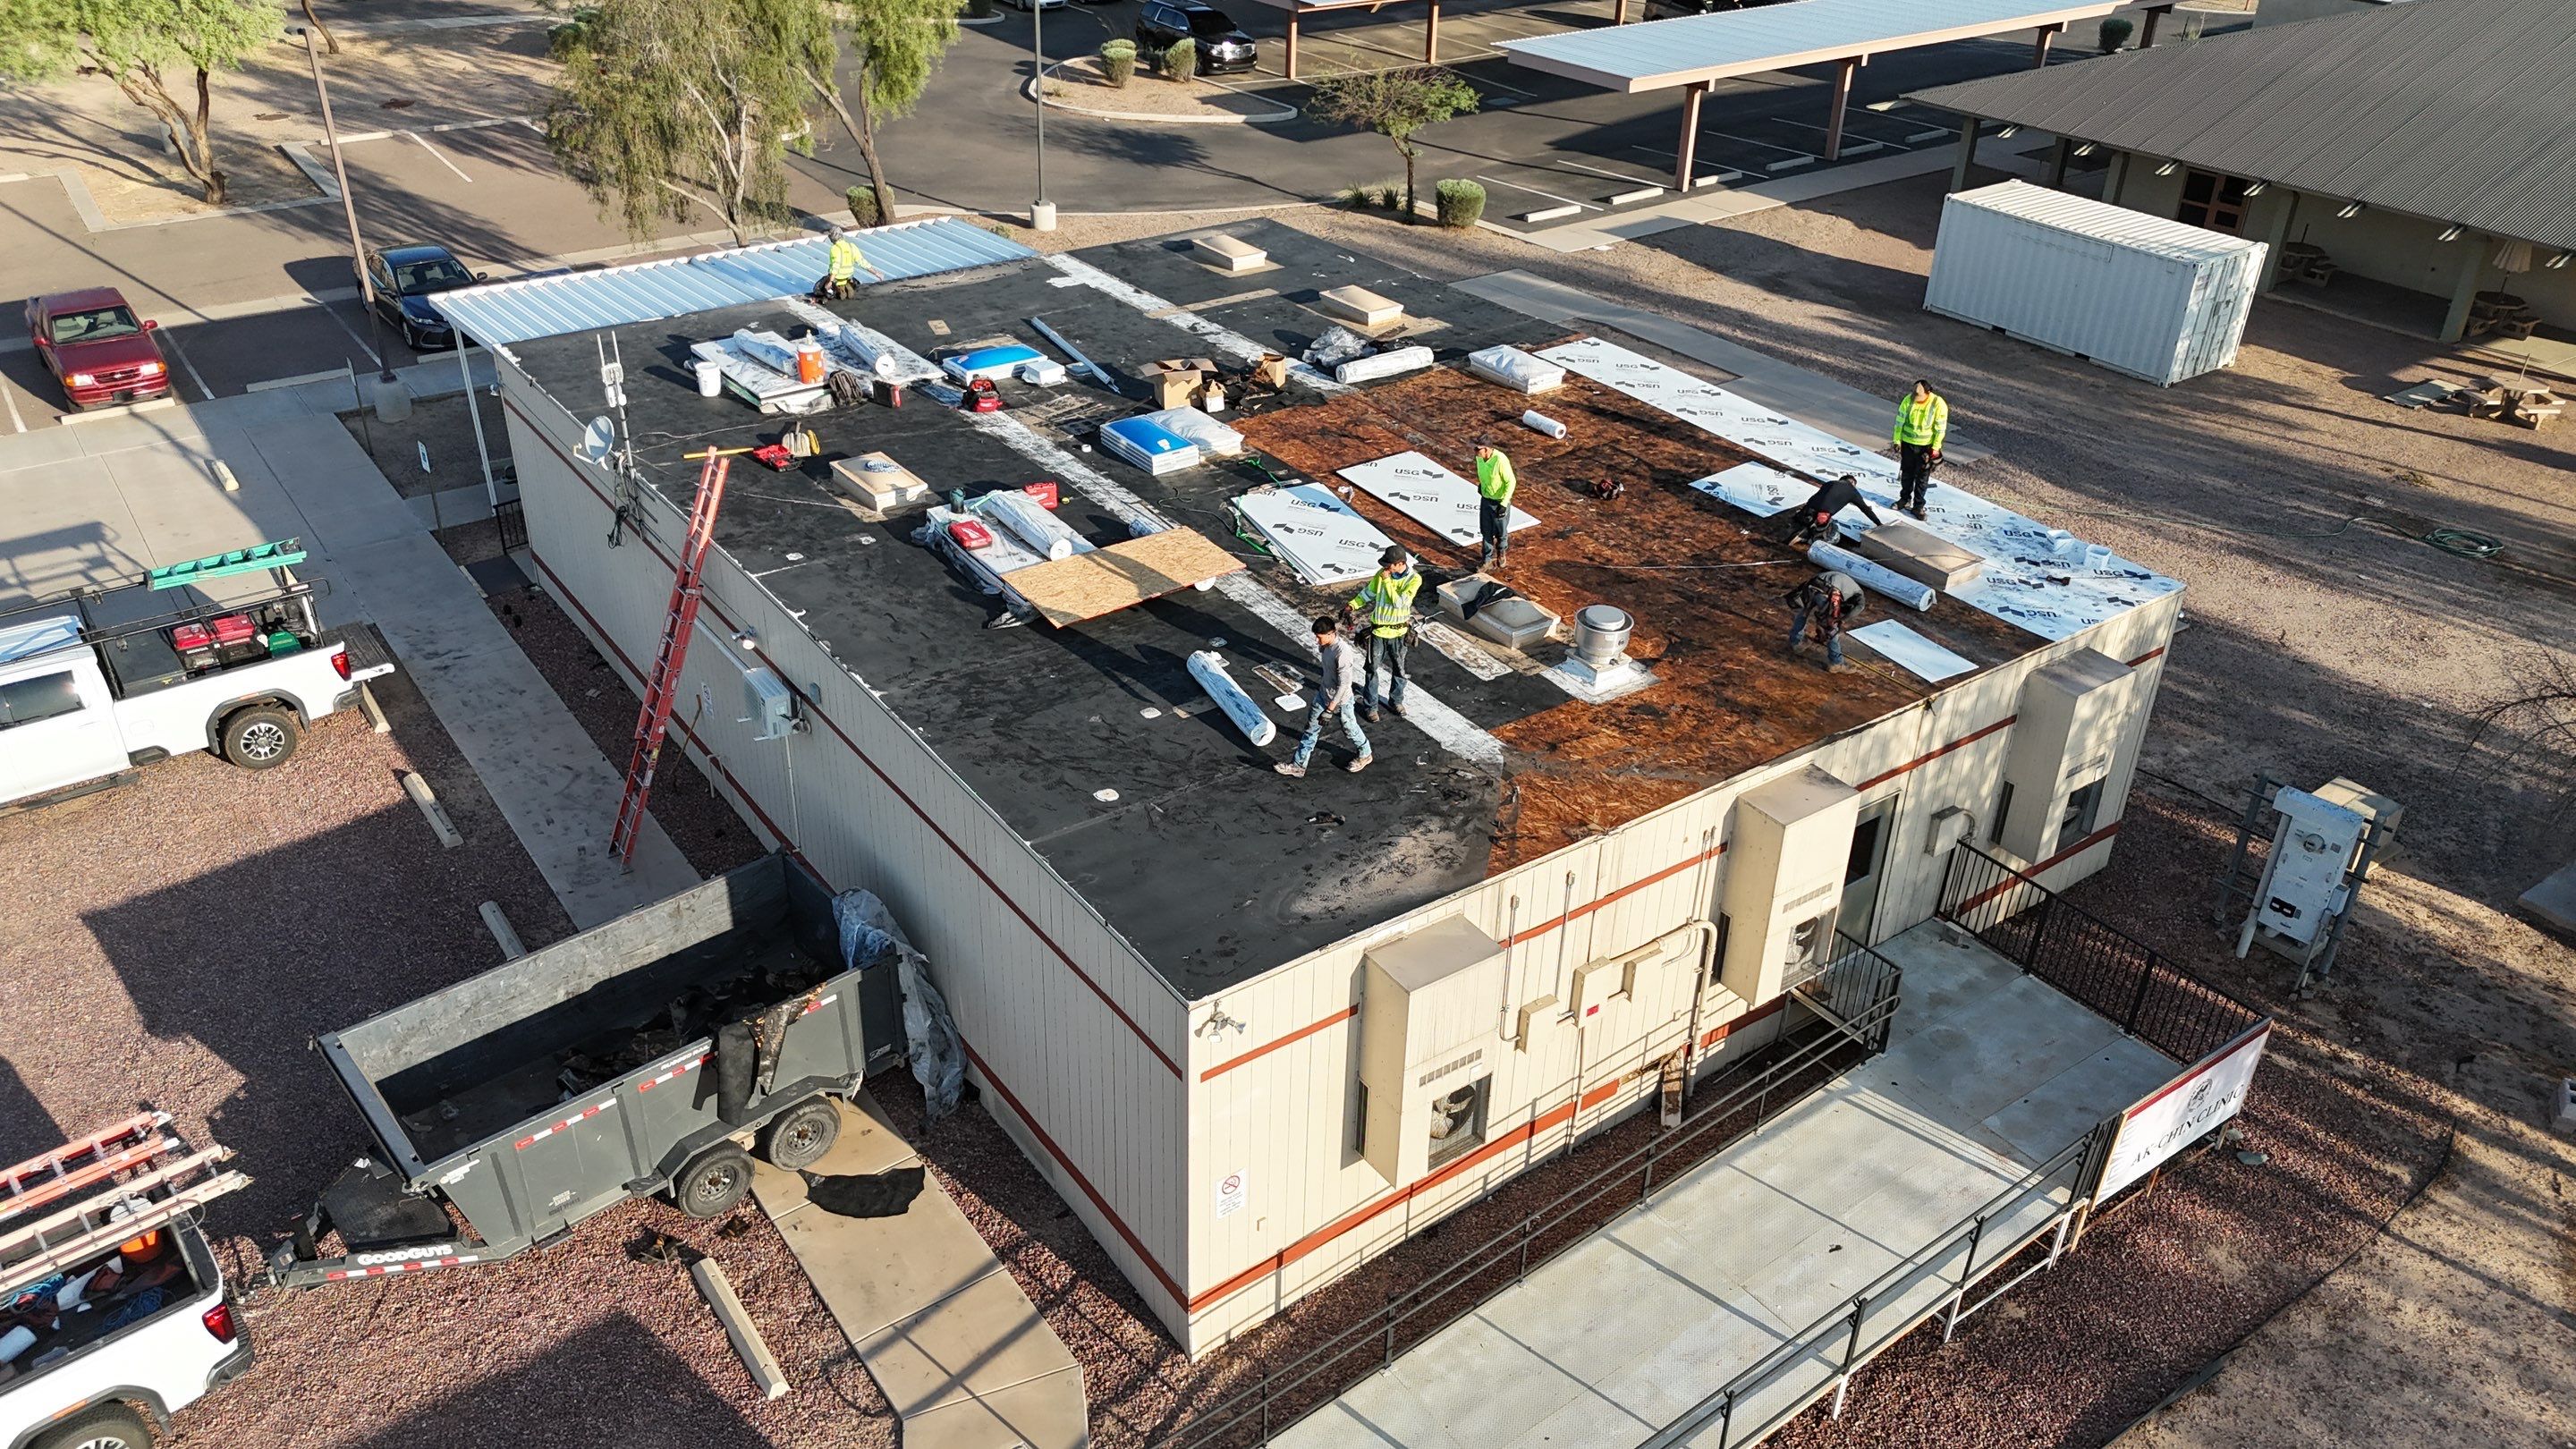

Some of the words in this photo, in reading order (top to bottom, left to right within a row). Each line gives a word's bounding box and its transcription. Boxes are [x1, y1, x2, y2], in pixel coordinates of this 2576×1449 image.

[1395, 468, 1419, 476] USG
[1291, 499, 1317, 508] USG
[1297, 528, 1324, 537] USG
[2004, 530, 2033, 538] USG
[1339, 538, 1366, 548] USG
[2093, 568, 2123, 577] USG
[1986, 577, 2017, 586] USG
[2026, 609, 2058, 618] USG
[2197, 1084, 2244, 1123] CLINIC
